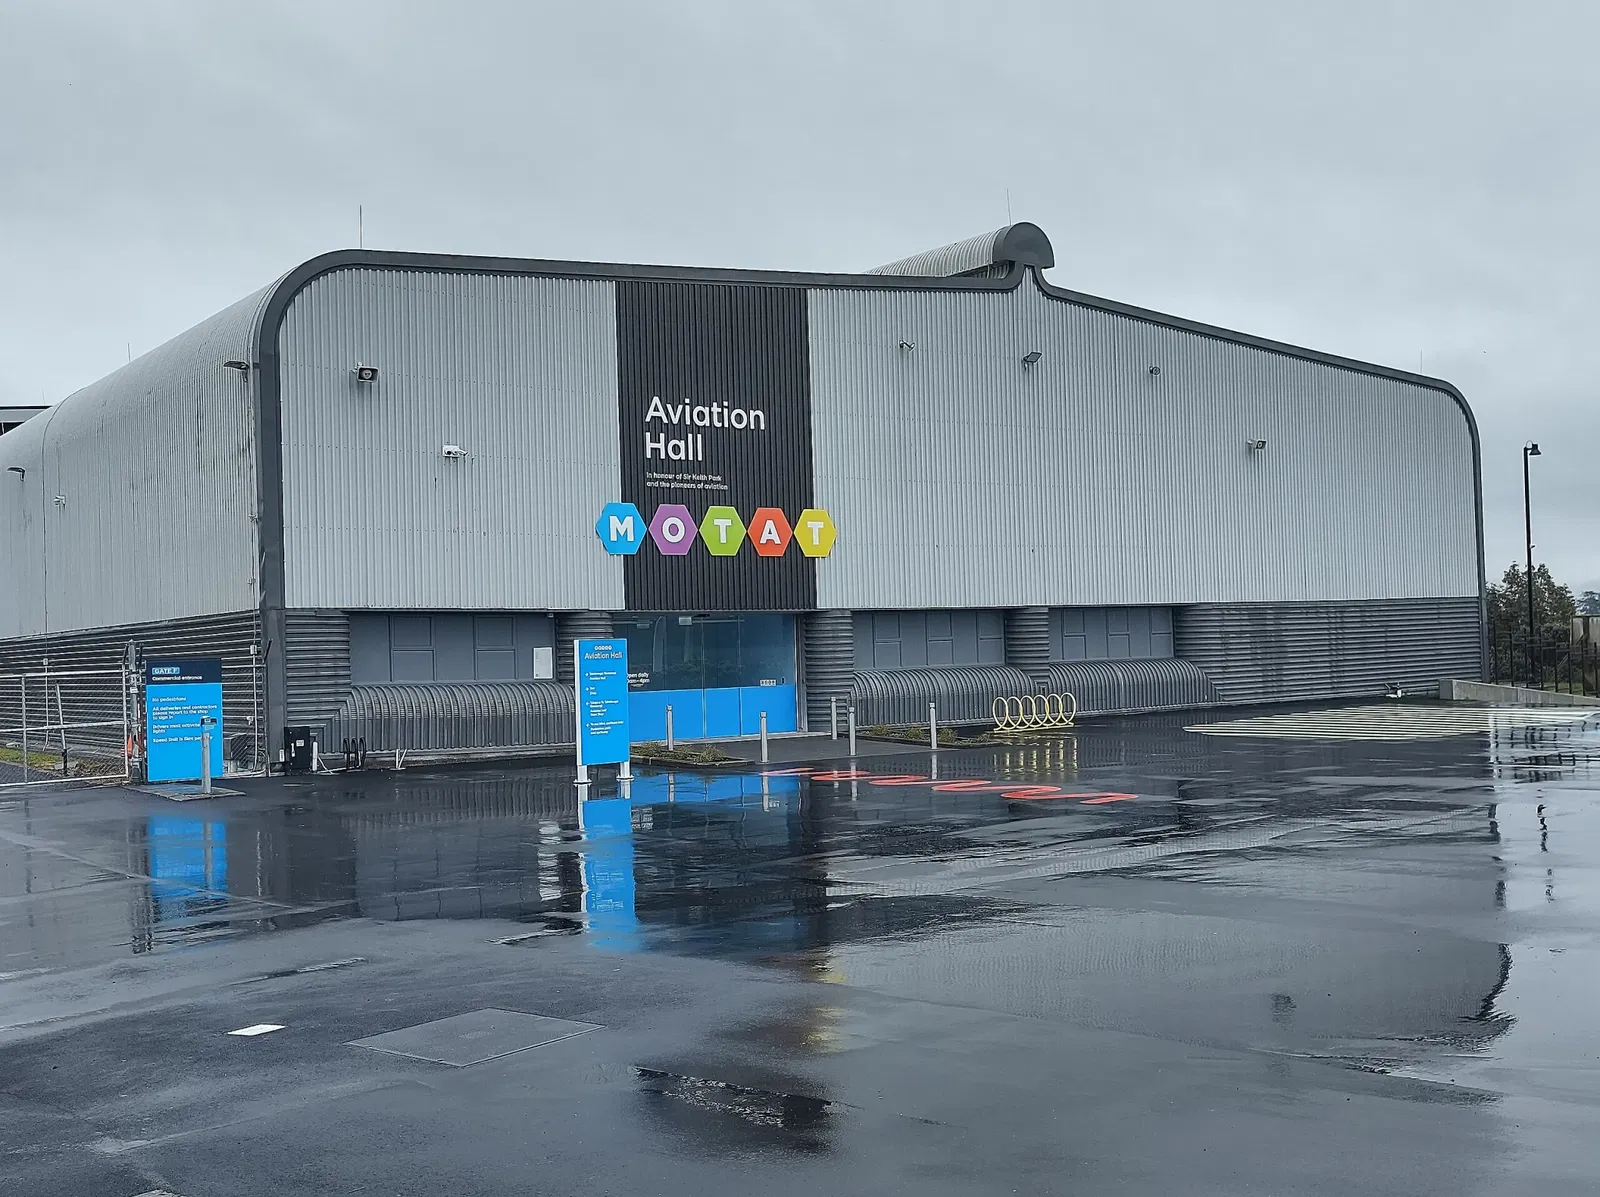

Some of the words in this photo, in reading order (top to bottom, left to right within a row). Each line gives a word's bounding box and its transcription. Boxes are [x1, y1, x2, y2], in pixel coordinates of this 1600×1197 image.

[645, 396, 765, 430] Aviation
[645, 432, 703, 461] Hall
[609, 515, 824, 546] MOTAT
